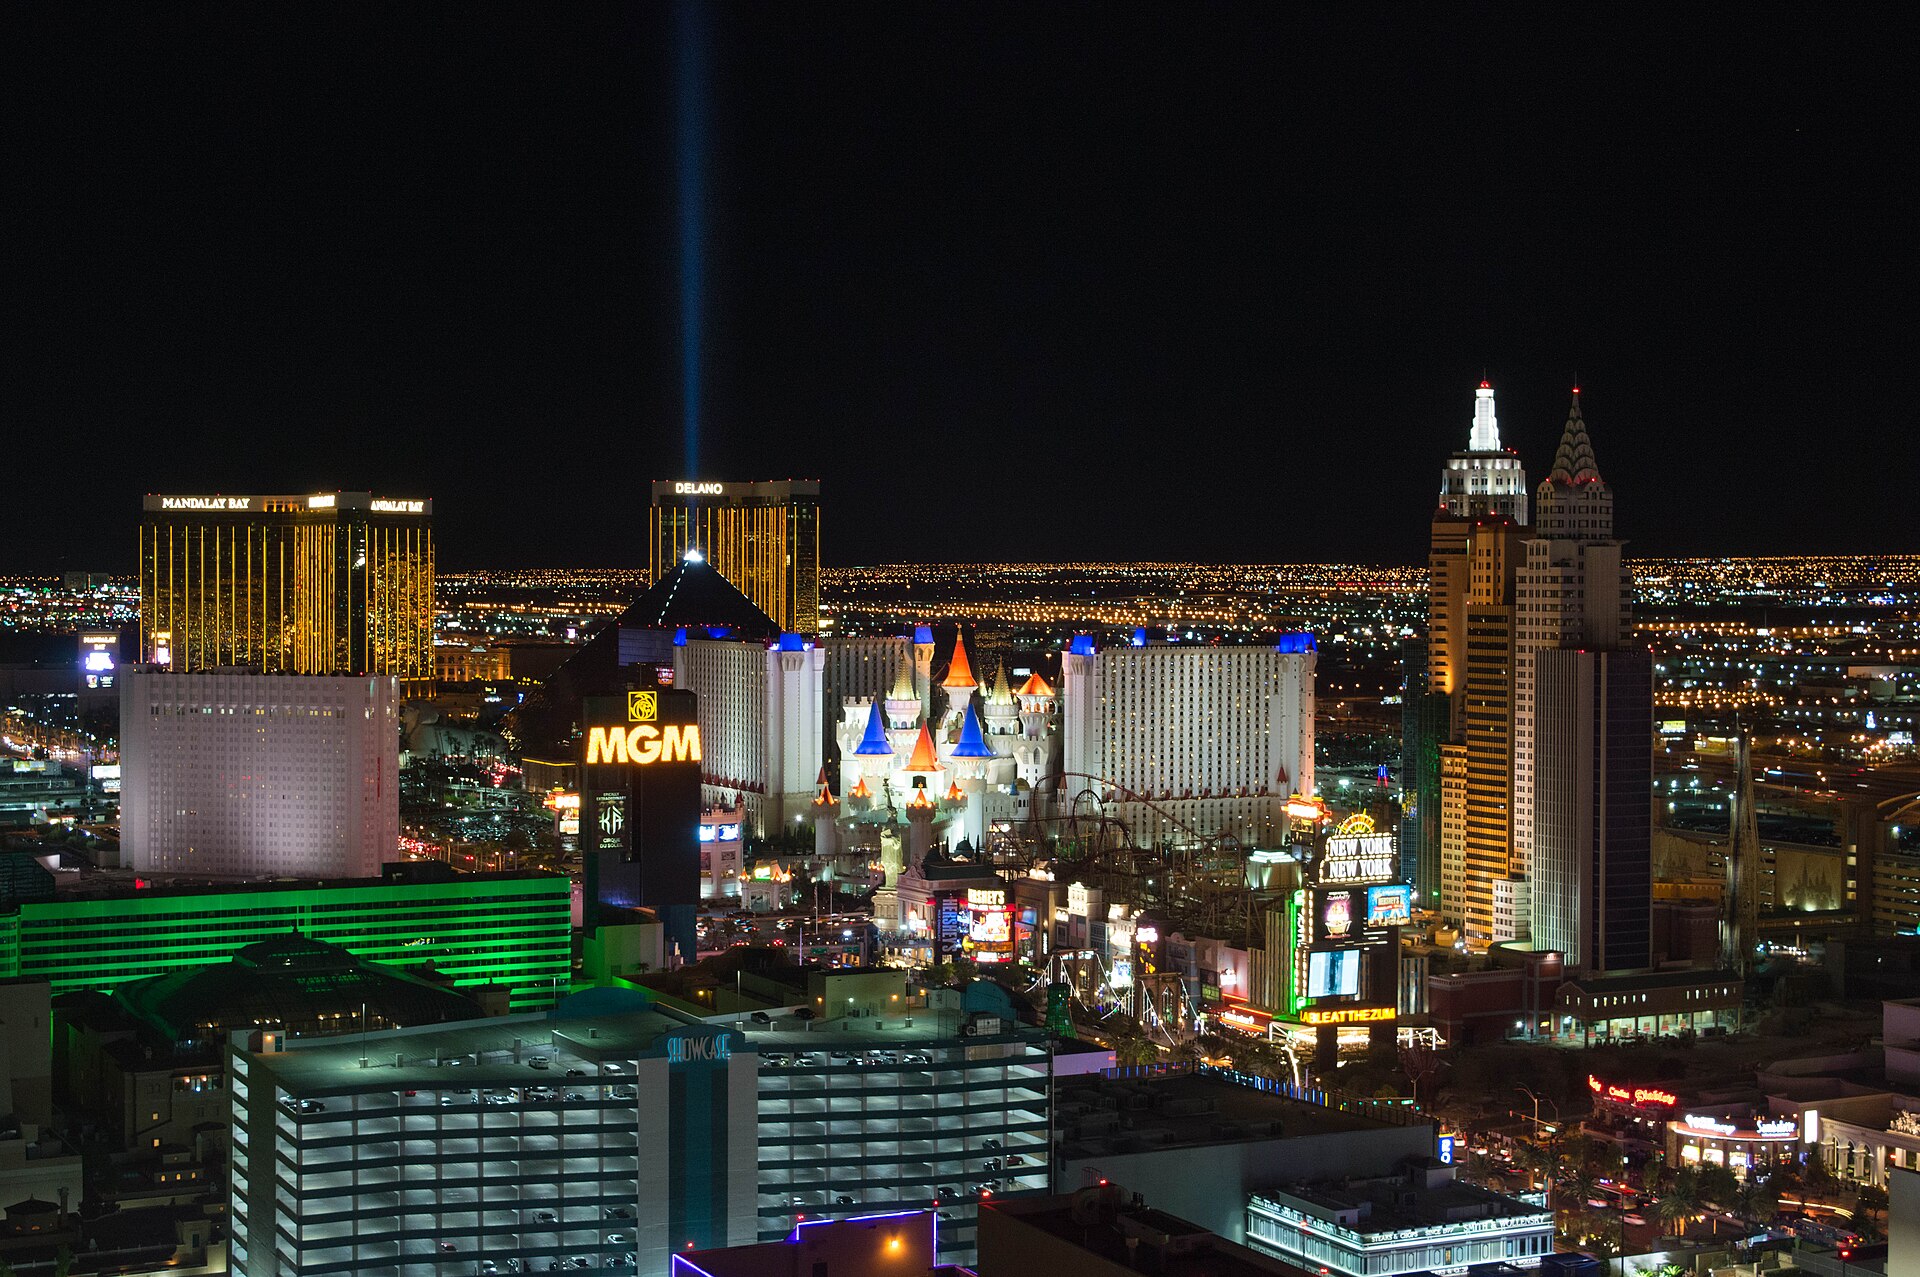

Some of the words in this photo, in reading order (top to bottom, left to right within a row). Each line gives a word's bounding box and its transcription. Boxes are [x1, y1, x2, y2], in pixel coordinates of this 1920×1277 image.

[675, 482, 723, 495] DELANO
[161, 498, 226, 509] MANDALAY
[228, 498, 250, 509] BAY
[408, 501, 424, 512] BAY
[586, 724, 702, 765] MGM
[1329, 838, 1358, 856] NEW
[1359, 837, 1393, 855] YORK
[1329, 860, 1358, 878] NEW
[1359, 858, 1393, 877] YORK
[942, 898, 958, 952] HERSHEY'S
[667, 1033, 731, 1064] SHOWCASE
[1371, 1234, 1393, 1243] STEAKS
[1400, 1230, 1419, 1239] CHOPS
[1425, 1228, 1441, 1237] SINCE
[1463, 1221, 1488, 1233] SMITH
[1491, 1220, 1497, 1229] &
[1499, 1215, 1546, 1229] WOLLENSKY
